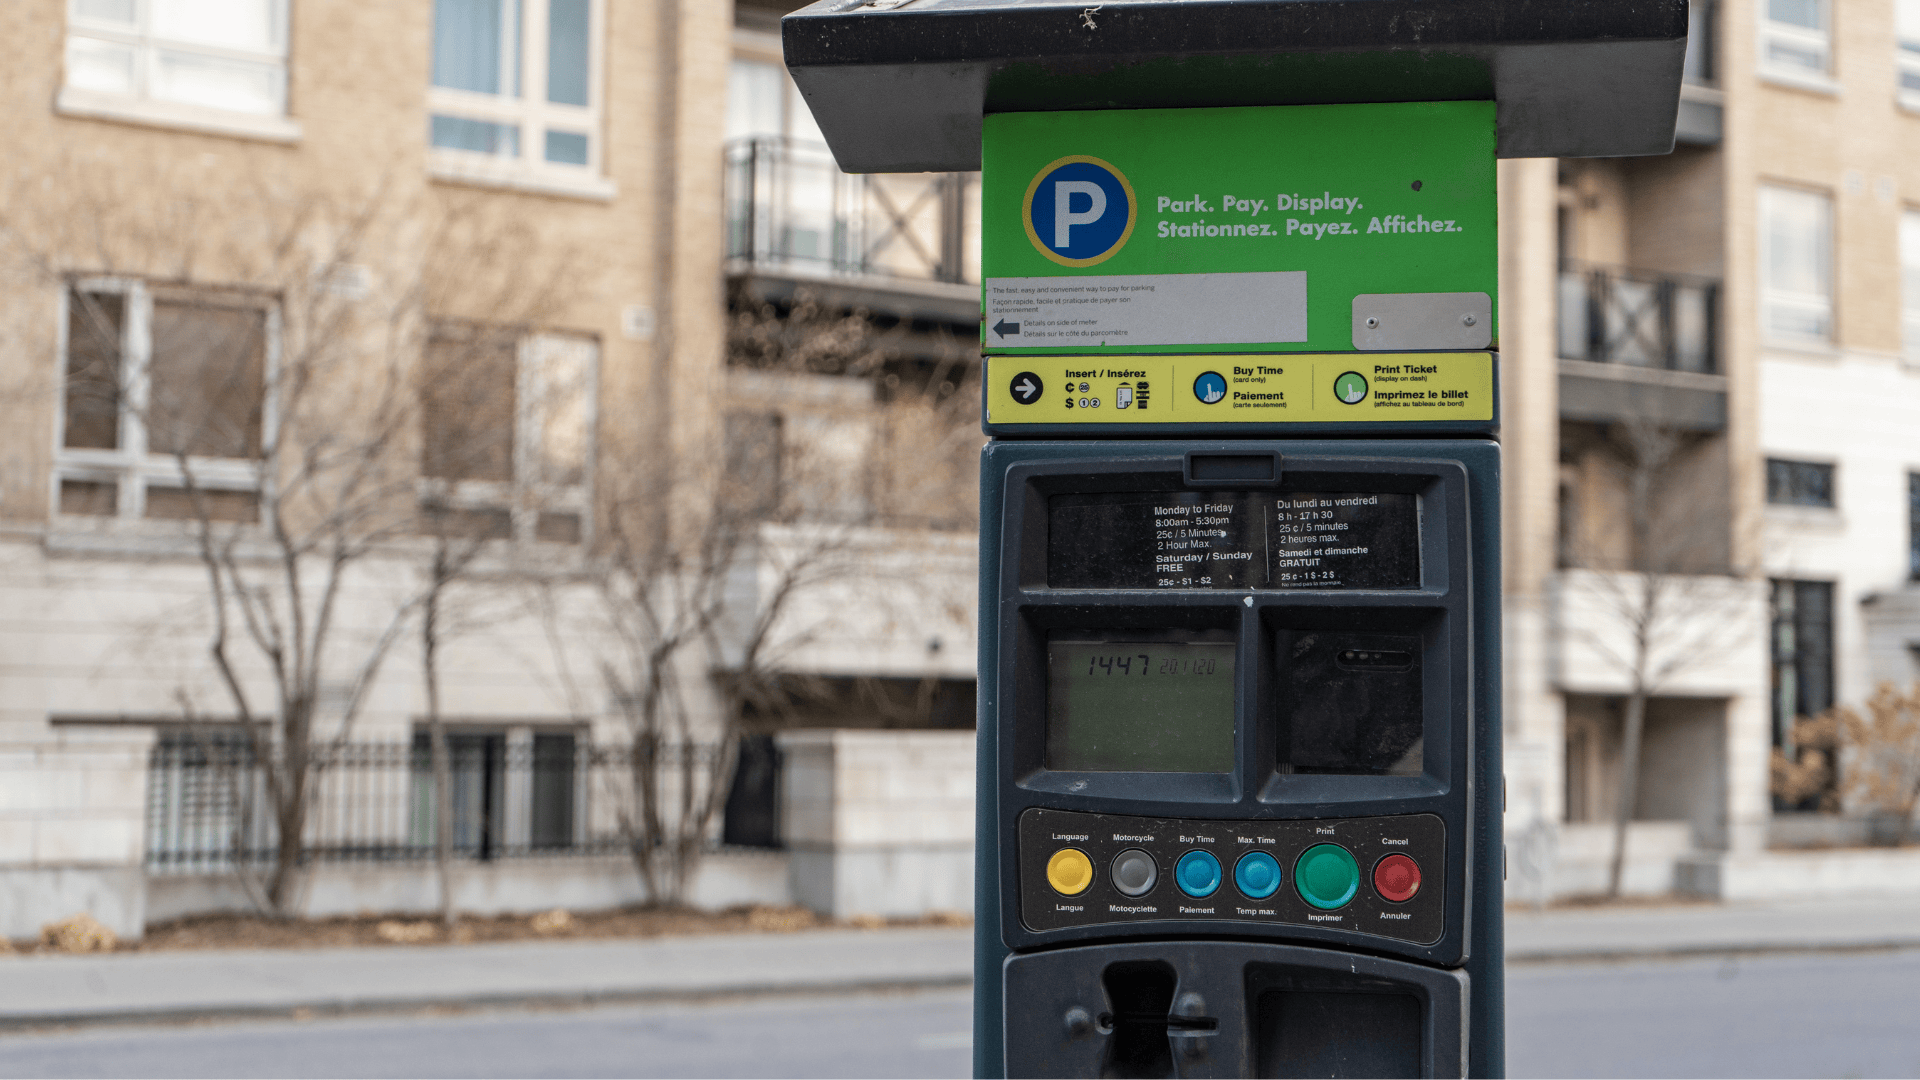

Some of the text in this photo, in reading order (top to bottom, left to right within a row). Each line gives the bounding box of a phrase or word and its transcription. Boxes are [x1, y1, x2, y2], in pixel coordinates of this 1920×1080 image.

[1157, 191, 1363, 216] Park. Pay. Display.
[1054, 180, 1107, 248] P
[1157, 214, 1463, 240] Stationnez. Payez. Affichez.
[993, 298, 1012, 306] Façon
[1062, 297, 1089, 305] pratique
[993, 306, 1039, 314] stationnement
[1065, 368, 1146, 378] Insert / Insérez
[1233, 366, 1284, 376] Buy Time
[1374, 365, 1437, 374] Print Ticket
[1233, 391, 1284, 400] Paiement
[1374, 390, 1469, 401] Imprimez le billet
[1065, 397, 1074, 410] $
[1447, 400, 1464, 408] bord)
[1277, 495, 1378, 509] Du lundi au vendredi
[1154, 503, 1234, 516] Monday to Friday
[1278, 512, 1284, 521] 8
[1286, 512, 1292, 520] h
[1299, 511, 1311, 520] 17
[1313, 511, 1319, 519] h
[1321, 510, 1333, 519] 30
[1155, 518, 1189, 527] 8:00am
[1195, 516, 1230, 526] 5:30pm
[1279, 524, 1291, 533] 25
[1300, 523, 1304, 532] /
[1306, 523, 1312, 531] 5
[1314, 522, 1349, 531] minutes
[1174, 529, 1179, 538] /
[1180, 529, 1186, 538] 5
[1188, 528, 1223, 538] Minutes
[1280, 534, 1340, 544] 2 heures max.
[1157, 539, 1212, 550] 2 Hour Max.
[1156, 551, 1253, 563] Saturday / Sunday
[1279, 546, 1369, 558] Samedi et dimanche
[1156, 563, 1184, 572] FREE
[1279, 558, 1320, 568] GRATUIT
[1181, 577, 1192, 585] $1
[1200, 576, 1212, 585] $2
[1281, 572, 1291, 581] 25
[1310, 571, 1316, 580] $
[1322, 571, 1328, 579] 2
[1329, 570, 1335, 579] $
[1089, 654, 1150, 676] 1447
[1316, 827, 1335, 835] Print
[1052, 833, 1089, 842] Language
[1113, 833, 1154, 843] Motorcycle
[1179, 835, 1215, 844] Buy Time
[1237, 836, 1276, 844] Max. Time
[1381, 837, 1409, 846] Cancel
[1055, 904, 1084, 912] Langue
[1109, 904, 1157, 914] Motocyclette
[1179, 906, 1215, 914] Paiement
[1235, 907, 1277, 916] Temp max.
[1308, 913, 1343, 923] Imprimer
[1380, 911, 1411, 920] Annuler
